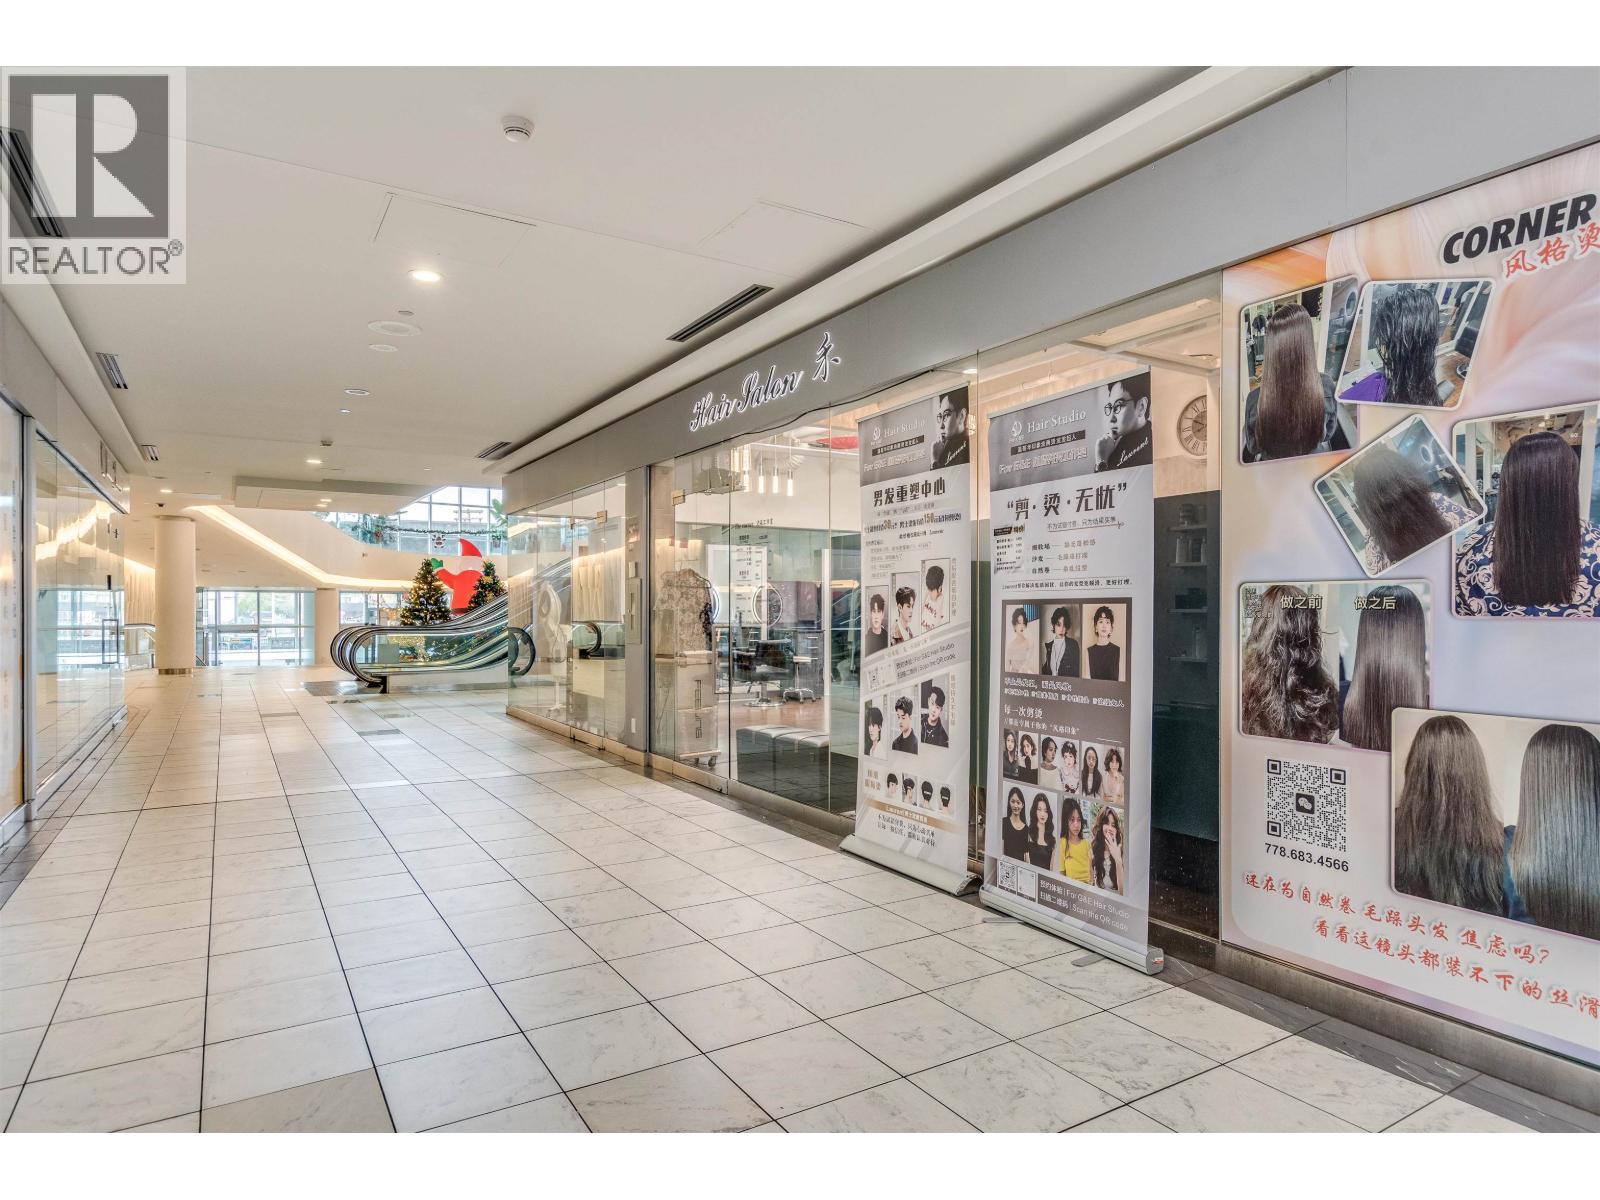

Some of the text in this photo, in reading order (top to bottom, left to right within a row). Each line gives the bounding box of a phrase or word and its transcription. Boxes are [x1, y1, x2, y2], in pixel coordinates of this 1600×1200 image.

[1443, 194, 1597, 264] CORNER
[689, 391, 737, 432] Hair
[737, 364, 804, 414] Salon
[1026, 408, 1087, 433] Hair Studio
[873, 477, 946, 508] 男发重塑中心
[1280, 595, 1324, 610] 做之前
[1354, 595, 1397, 610] 做之后
[1265, 842, 1349, 872] 778.683.4566
[1072, 903, 1088, 916] Scan
[1088, 910, 1099, 920] the
[1099, 914, 1111, 926] QR
